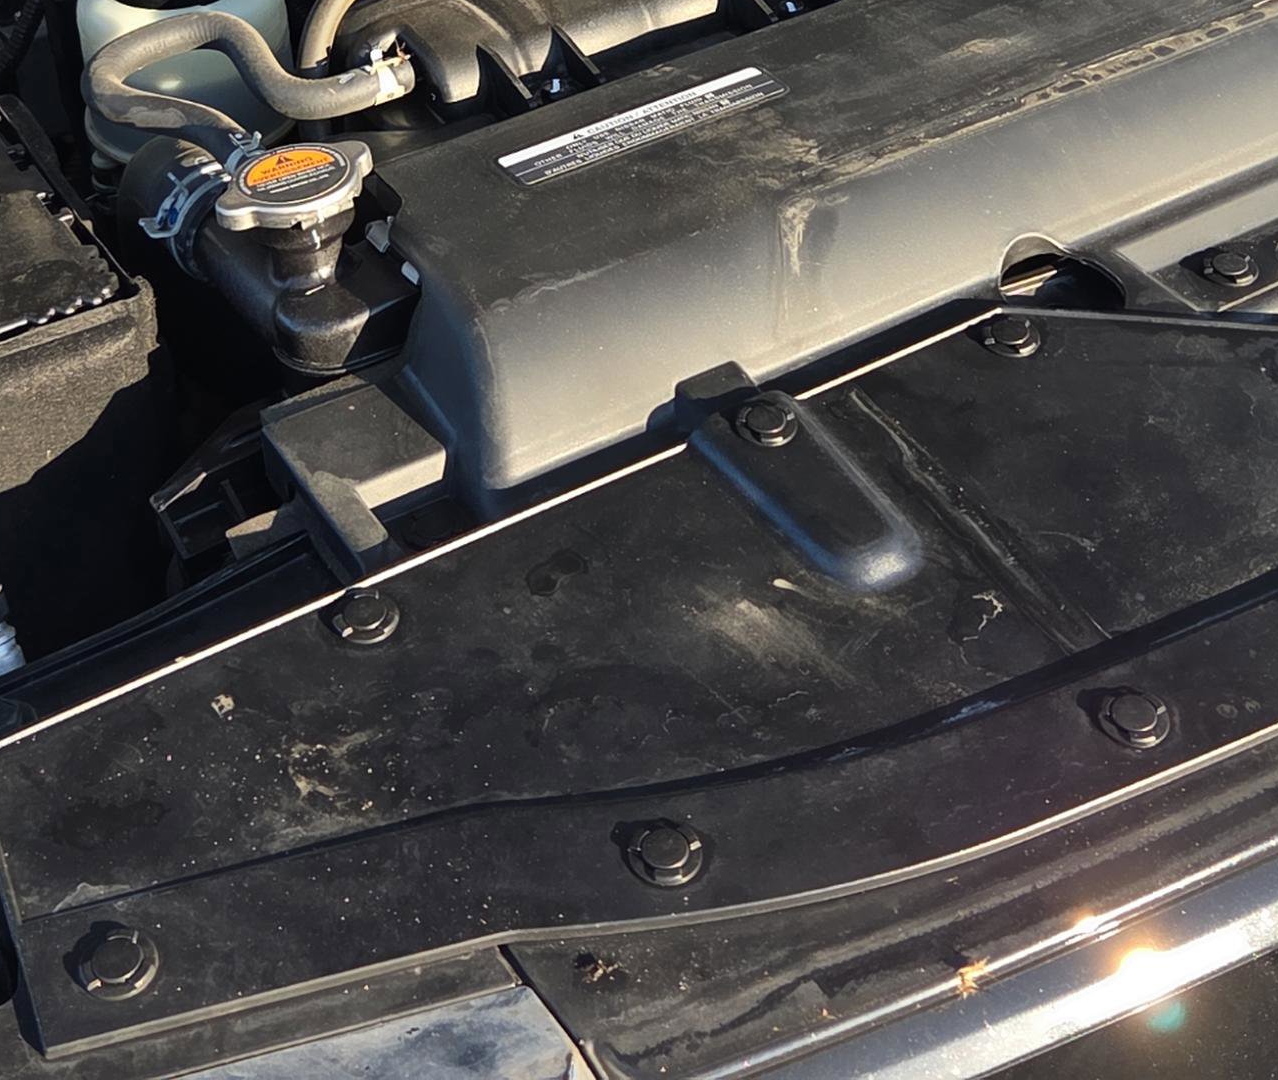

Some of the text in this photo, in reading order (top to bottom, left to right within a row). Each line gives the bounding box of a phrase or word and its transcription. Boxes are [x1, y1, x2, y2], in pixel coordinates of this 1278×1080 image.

[585, 113, 634, 134] CAUTION
[640, 90, 698, 114] ATTENTION
[262, 156, 314, 175] WARNING
